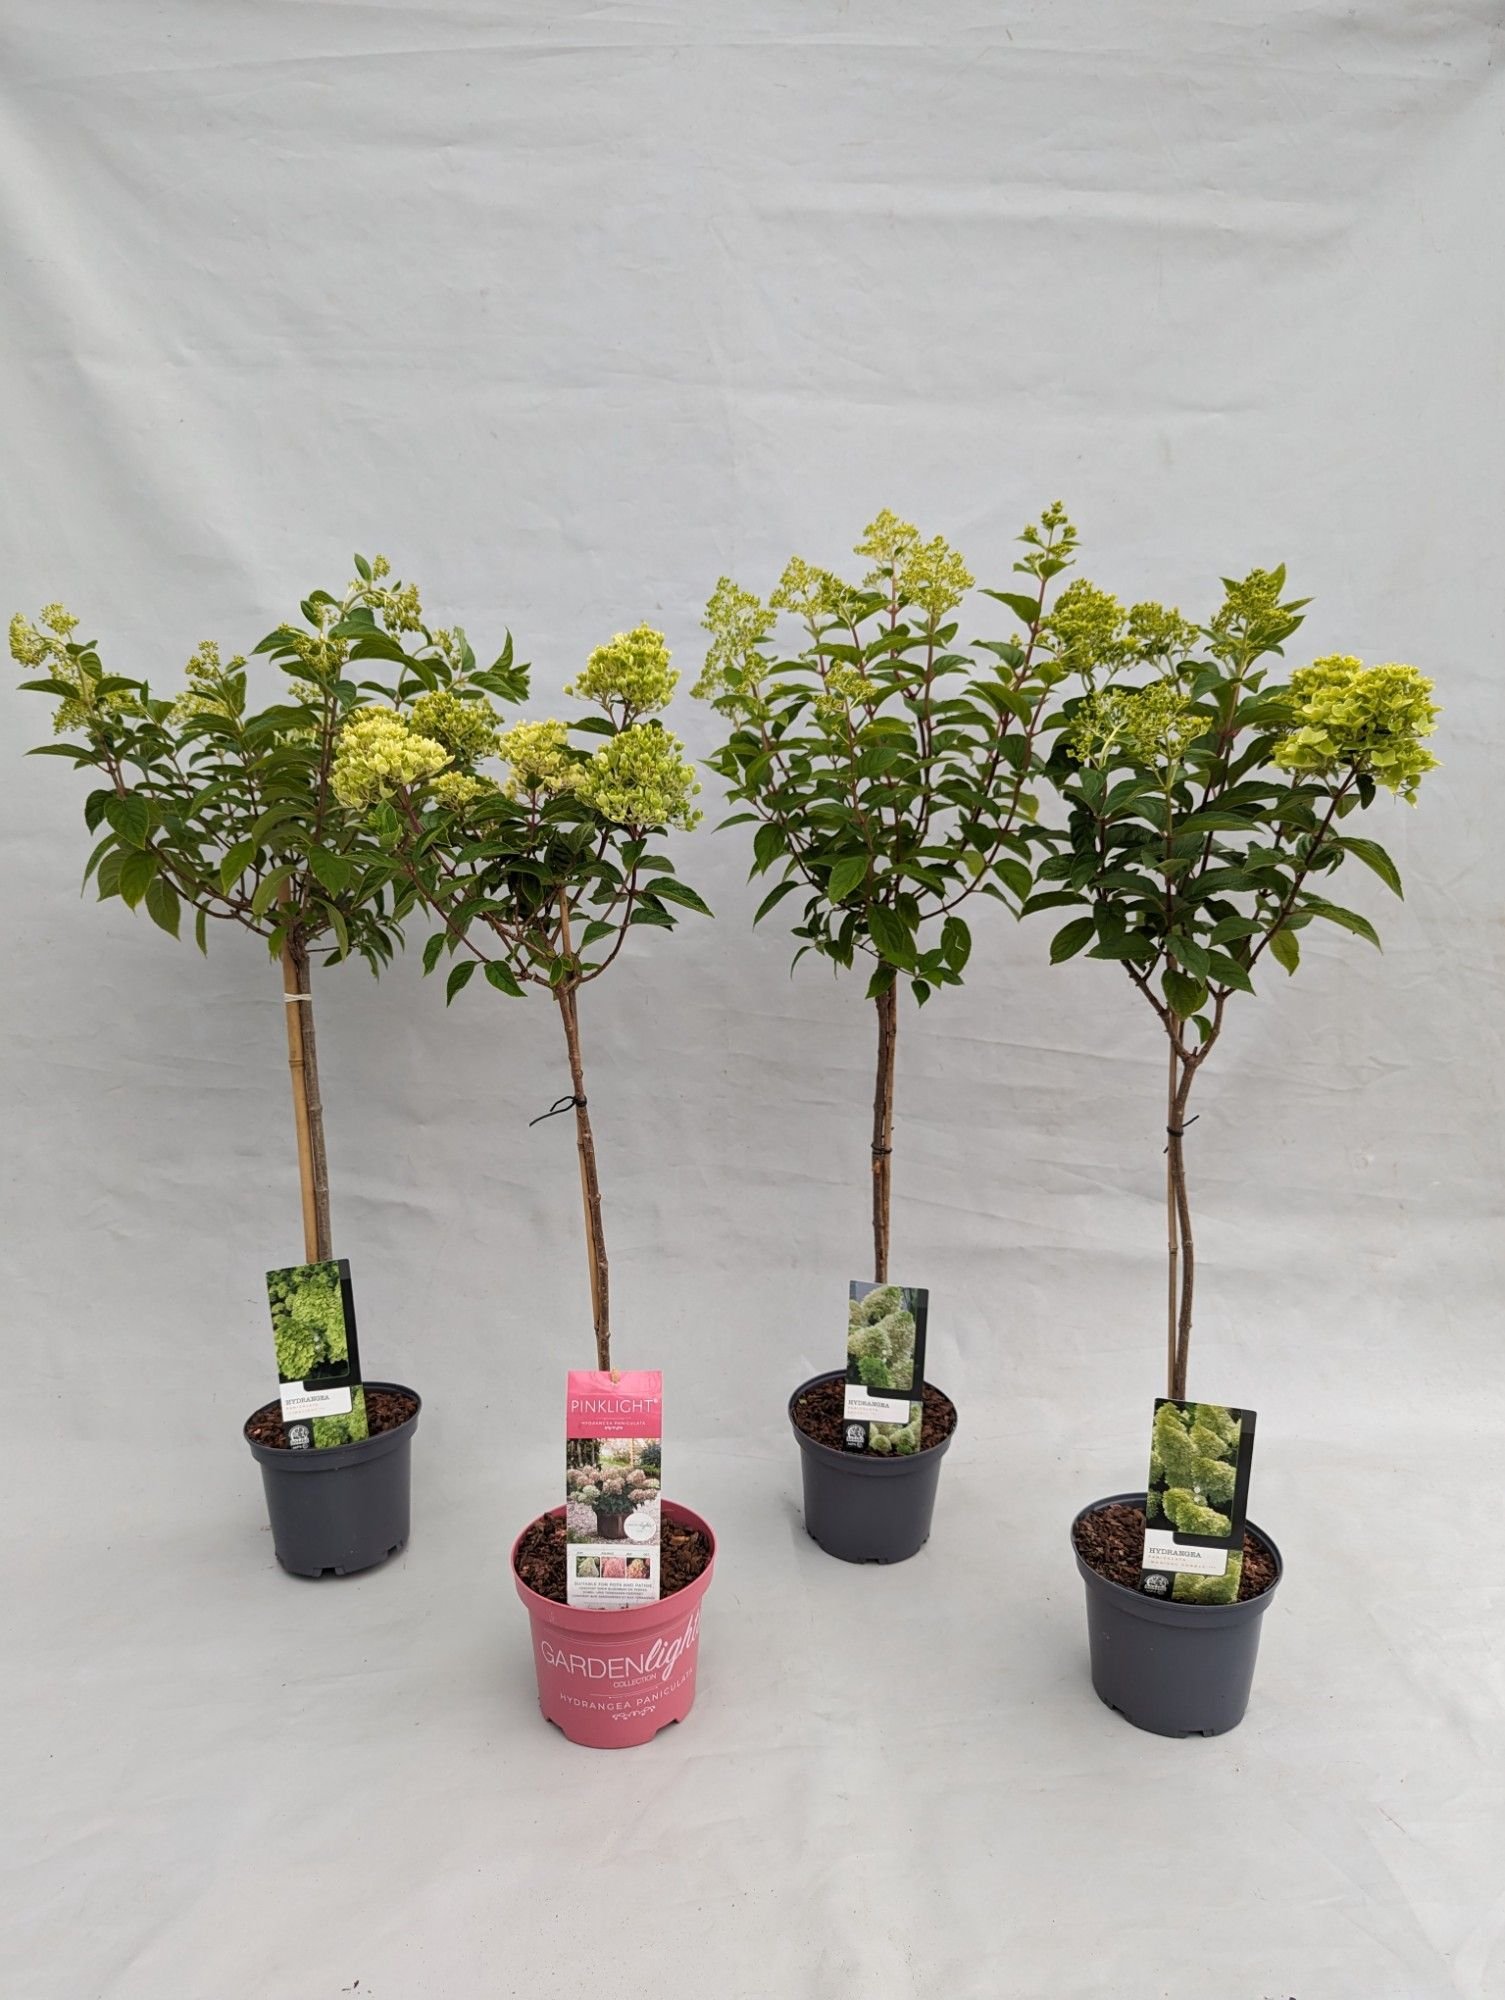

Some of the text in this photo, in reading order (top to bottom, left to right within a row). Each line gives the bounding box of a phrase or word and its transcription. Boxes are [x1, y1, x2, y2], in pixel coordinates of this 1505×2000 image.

[285, 1395, 330, 1406] HYDRANGEA
[848, 1399, 890, 1409] HYDRANGEA
[1148, 1547, 1202, 1559] HYDRANGEA
[613, 1673, 657, 1689] COLLECTION
[560, 1693, 632, 1711] HYDRANGEA
